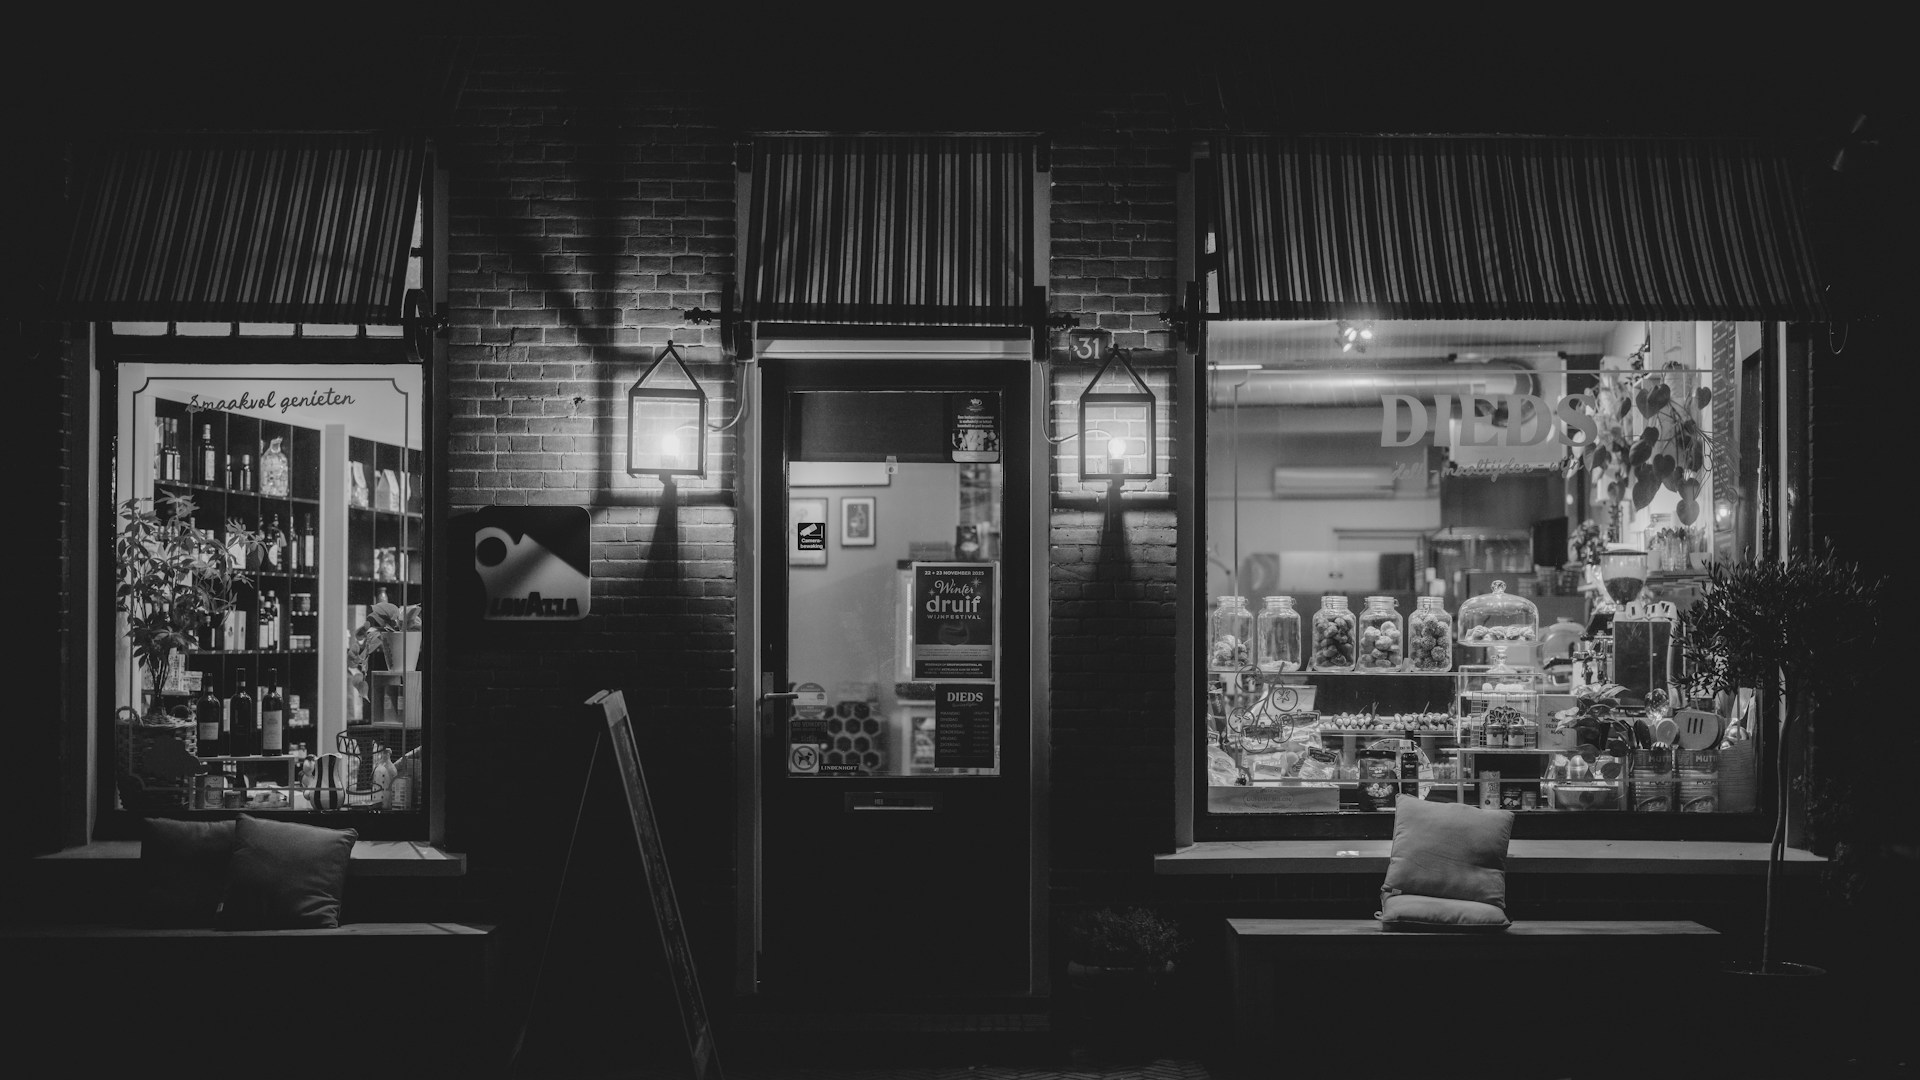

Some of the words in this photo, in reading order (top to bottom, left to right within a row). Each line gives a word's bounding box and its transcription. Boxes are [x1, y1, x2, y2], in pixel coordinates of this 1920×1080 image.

[1076, 337, 1100, 360] 31
[185, 391, 276, 413] Smaakvol
[281, 387, 356, 414] genieten
[1380, 393, 1598, 447] DIEDS
[1441, 456, 1534, 483] maaltijden
[1549, 454, 1585, 478] wijn
[934, 578, 974, 597] Winter
[489, 592, 579, 617] LAVAZZA
[925, 595, 982, 613] druif
[946, 692, 984, 702] DIEDS
